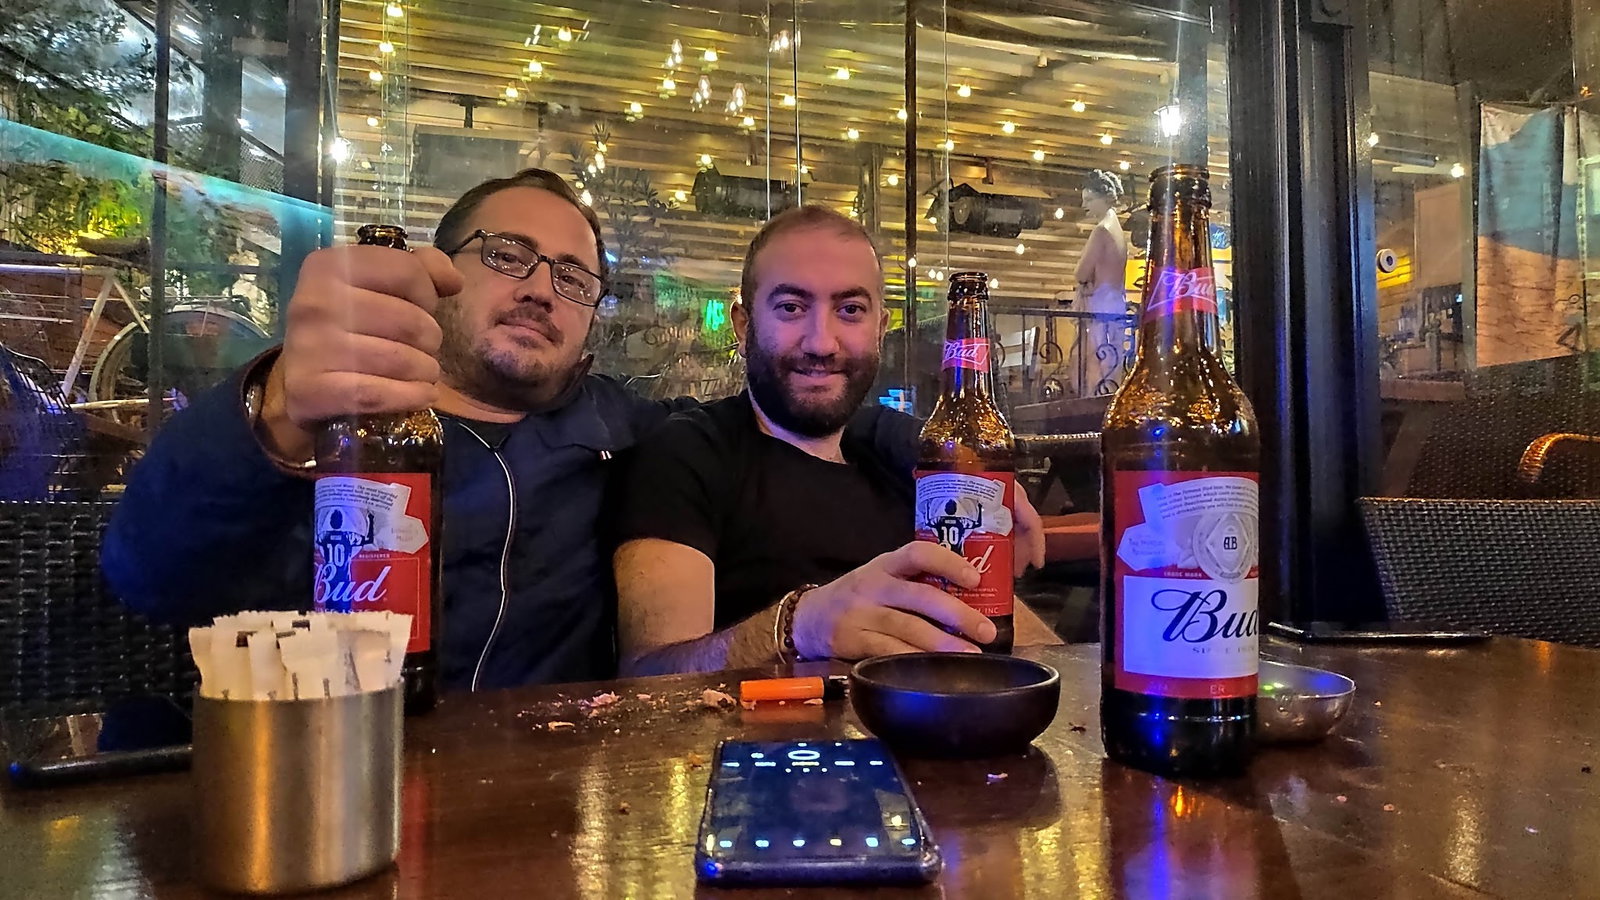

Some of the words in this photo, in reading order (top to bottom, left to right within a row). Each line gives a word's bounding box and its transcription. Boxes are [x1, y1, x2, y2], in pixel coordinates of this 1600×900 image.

[1163, 272, 1214, 297] Bu
[941, 526, 960, 546] 10
[1223, 536, 1238, 550] AB
[327, 543, 345, 567] 10
[314, 563, 392, 604] Bud
